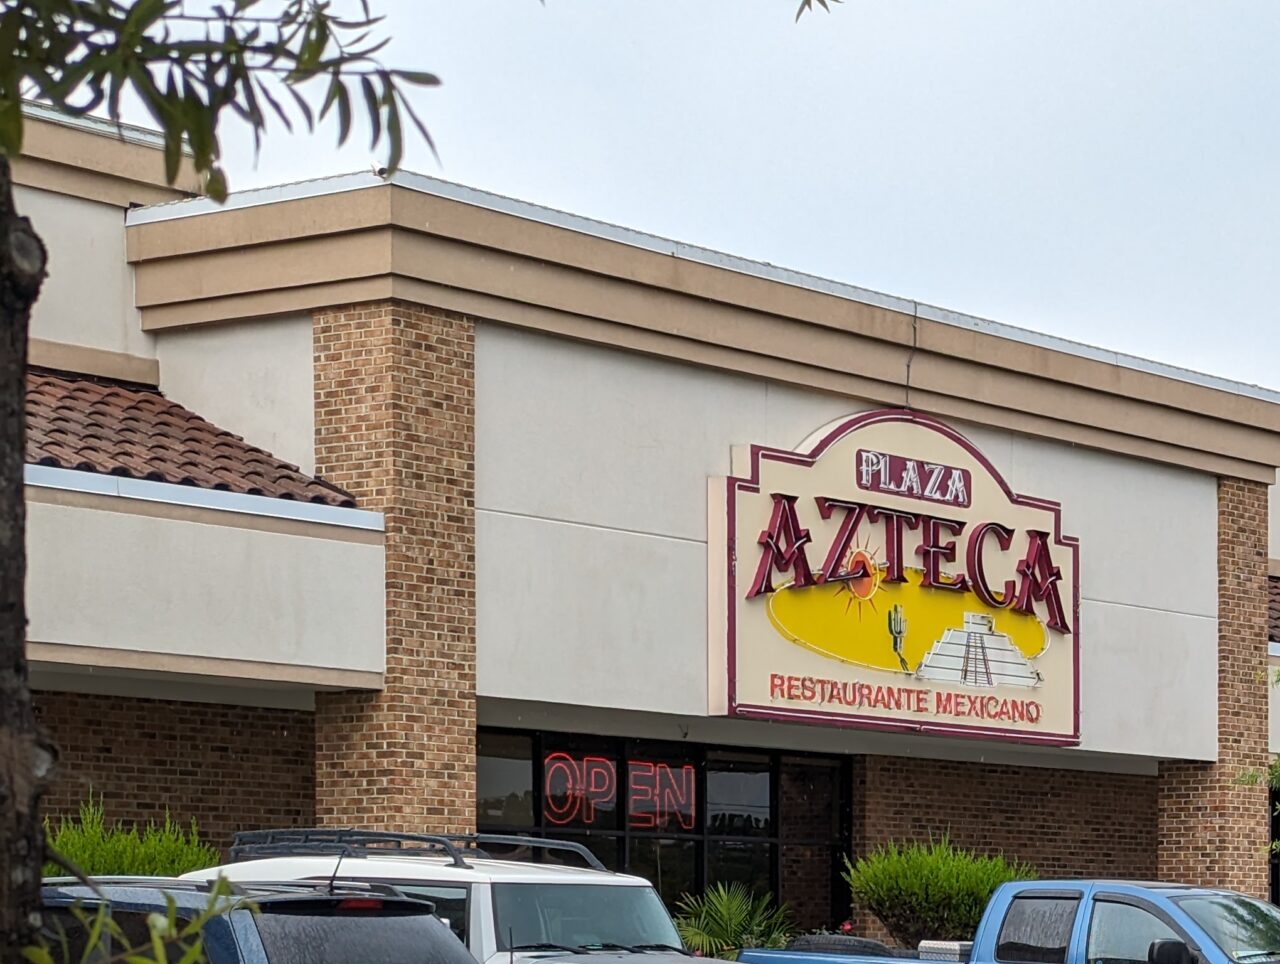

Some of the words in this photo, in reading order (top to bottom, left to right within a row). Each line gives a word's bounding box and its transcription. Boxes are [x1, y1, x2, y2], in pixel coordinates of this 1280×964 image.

[859, 451, 969, 506] PLAZA
[745, 493, 1071, 634] AZTECA
[770, 674, 929, 713] RESTAURANTE
[934, 691, 1041, 724] MEXICANO
[544, 752, 696, 829] OPEN
